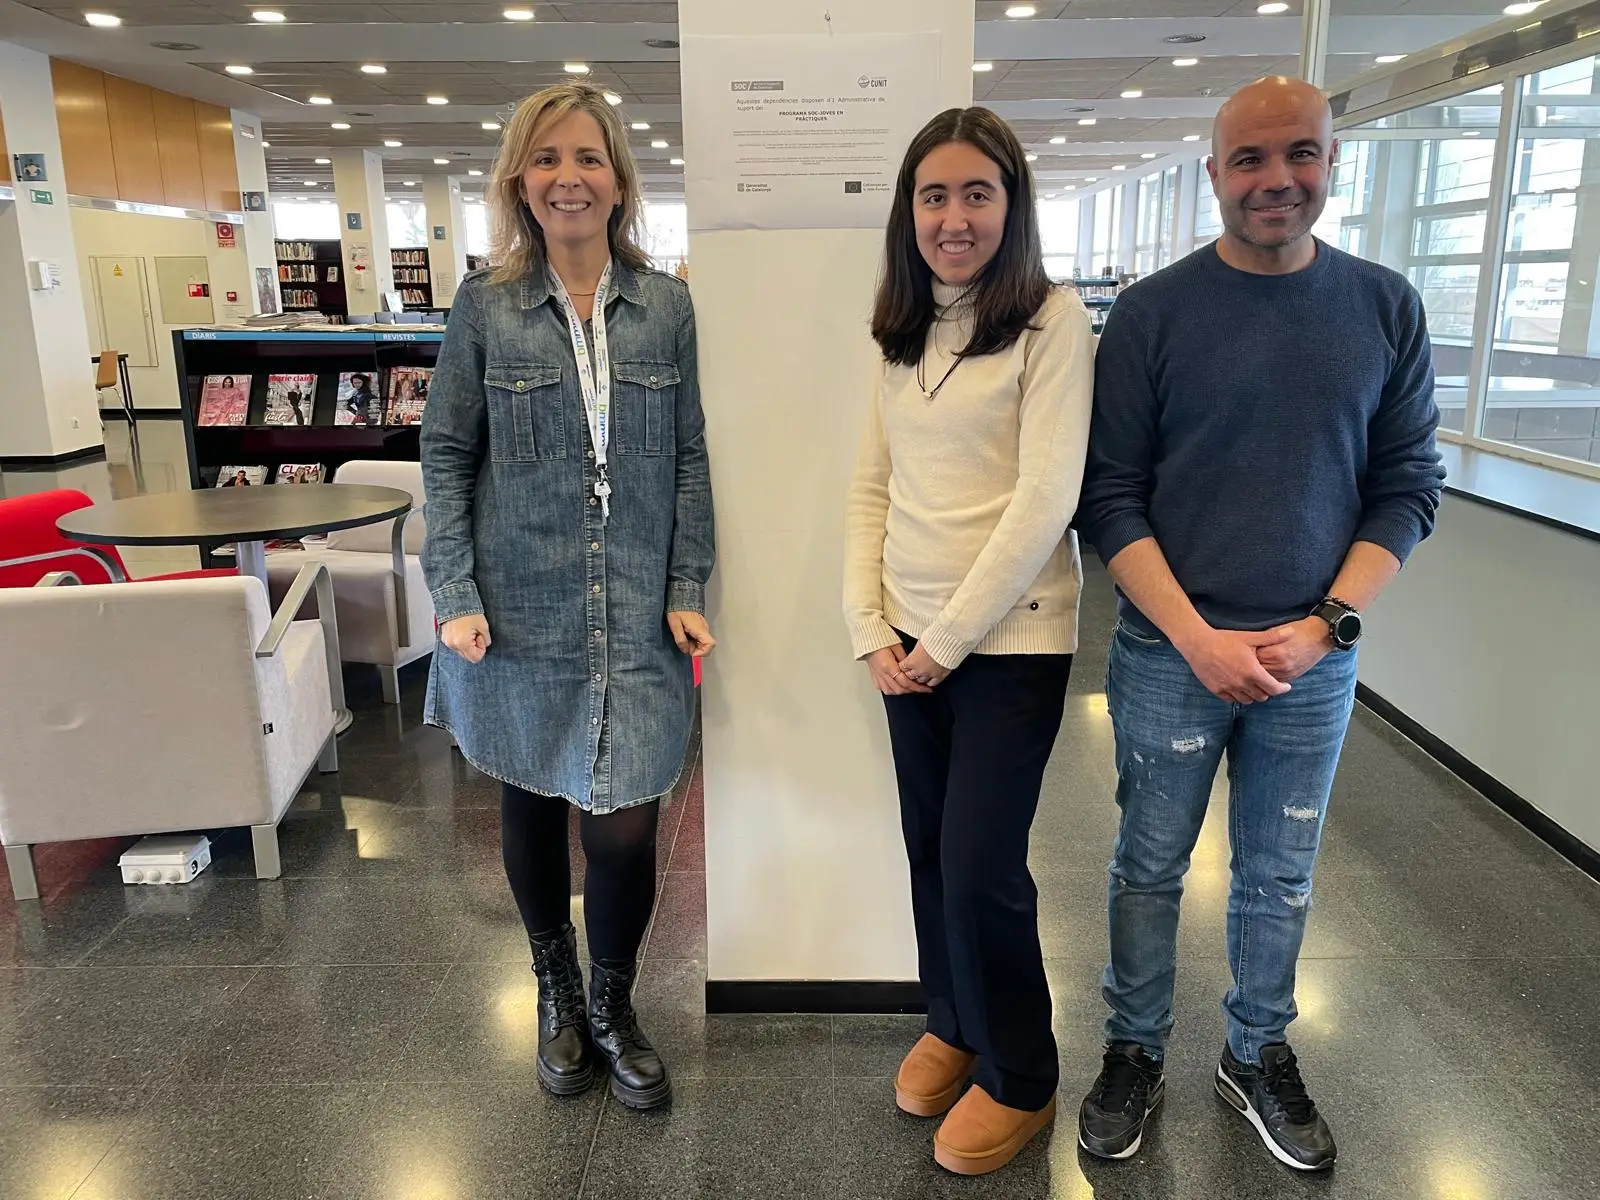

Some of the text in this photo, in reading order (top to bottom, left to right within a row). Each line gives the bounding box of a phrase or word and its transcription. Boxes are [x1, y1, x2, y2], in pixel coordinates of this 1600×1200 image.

[871, 79, 887, 87] CUNIT
[191, 332, 216, 340] DIARIS
[383, 333, 416, 341] REVISTES
[281, 465, 320, 475] CLRA
